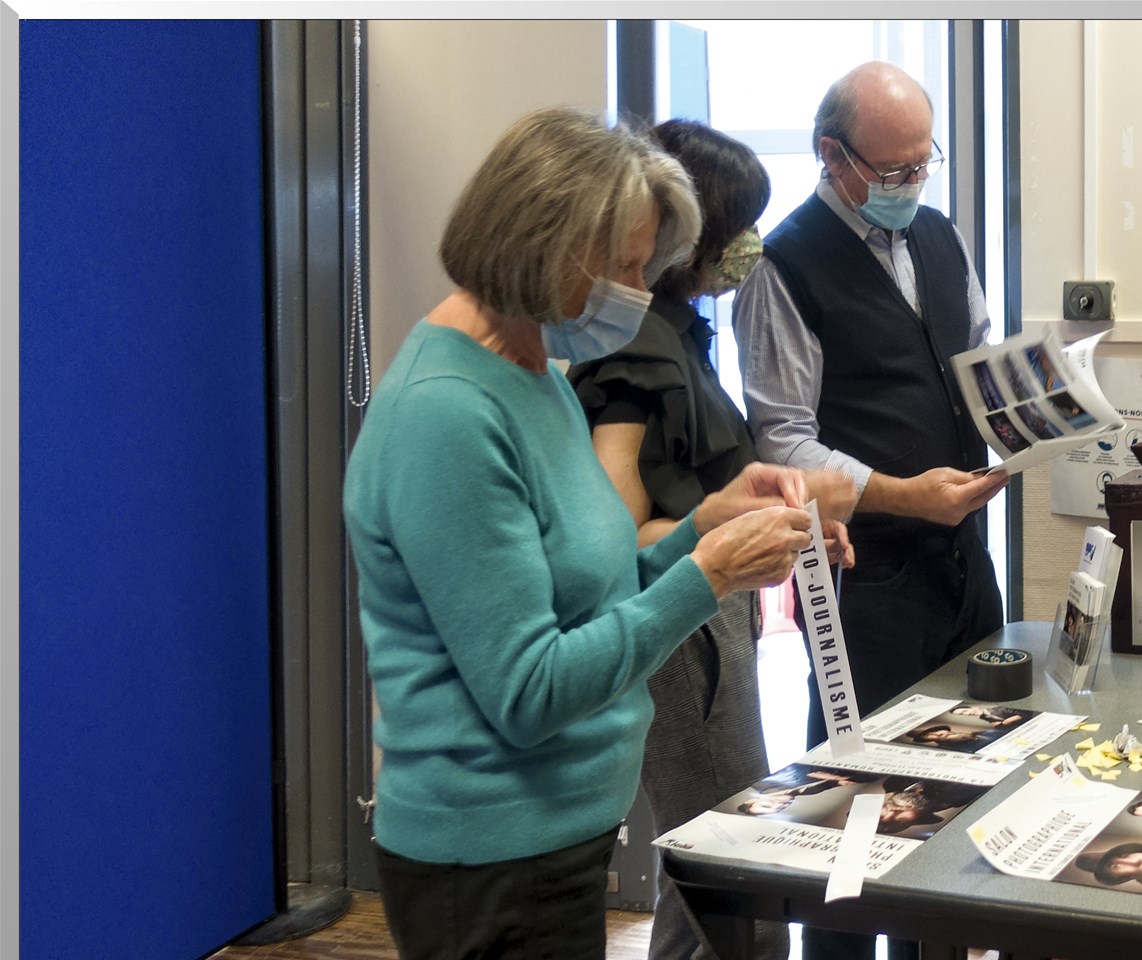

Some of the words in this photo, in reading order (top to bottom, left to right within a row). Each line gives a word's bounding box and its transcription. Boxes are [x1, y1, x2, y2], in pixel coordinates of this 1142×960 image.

[801, 533, 853, 736] TO-JOURNALISME
[984, 825, 1018, 857] SALON
[1003, 809, 1077, 870] PHOTOGRAPHIQUE
[1025, 821, 1092, 874] INTERNATIONAL
